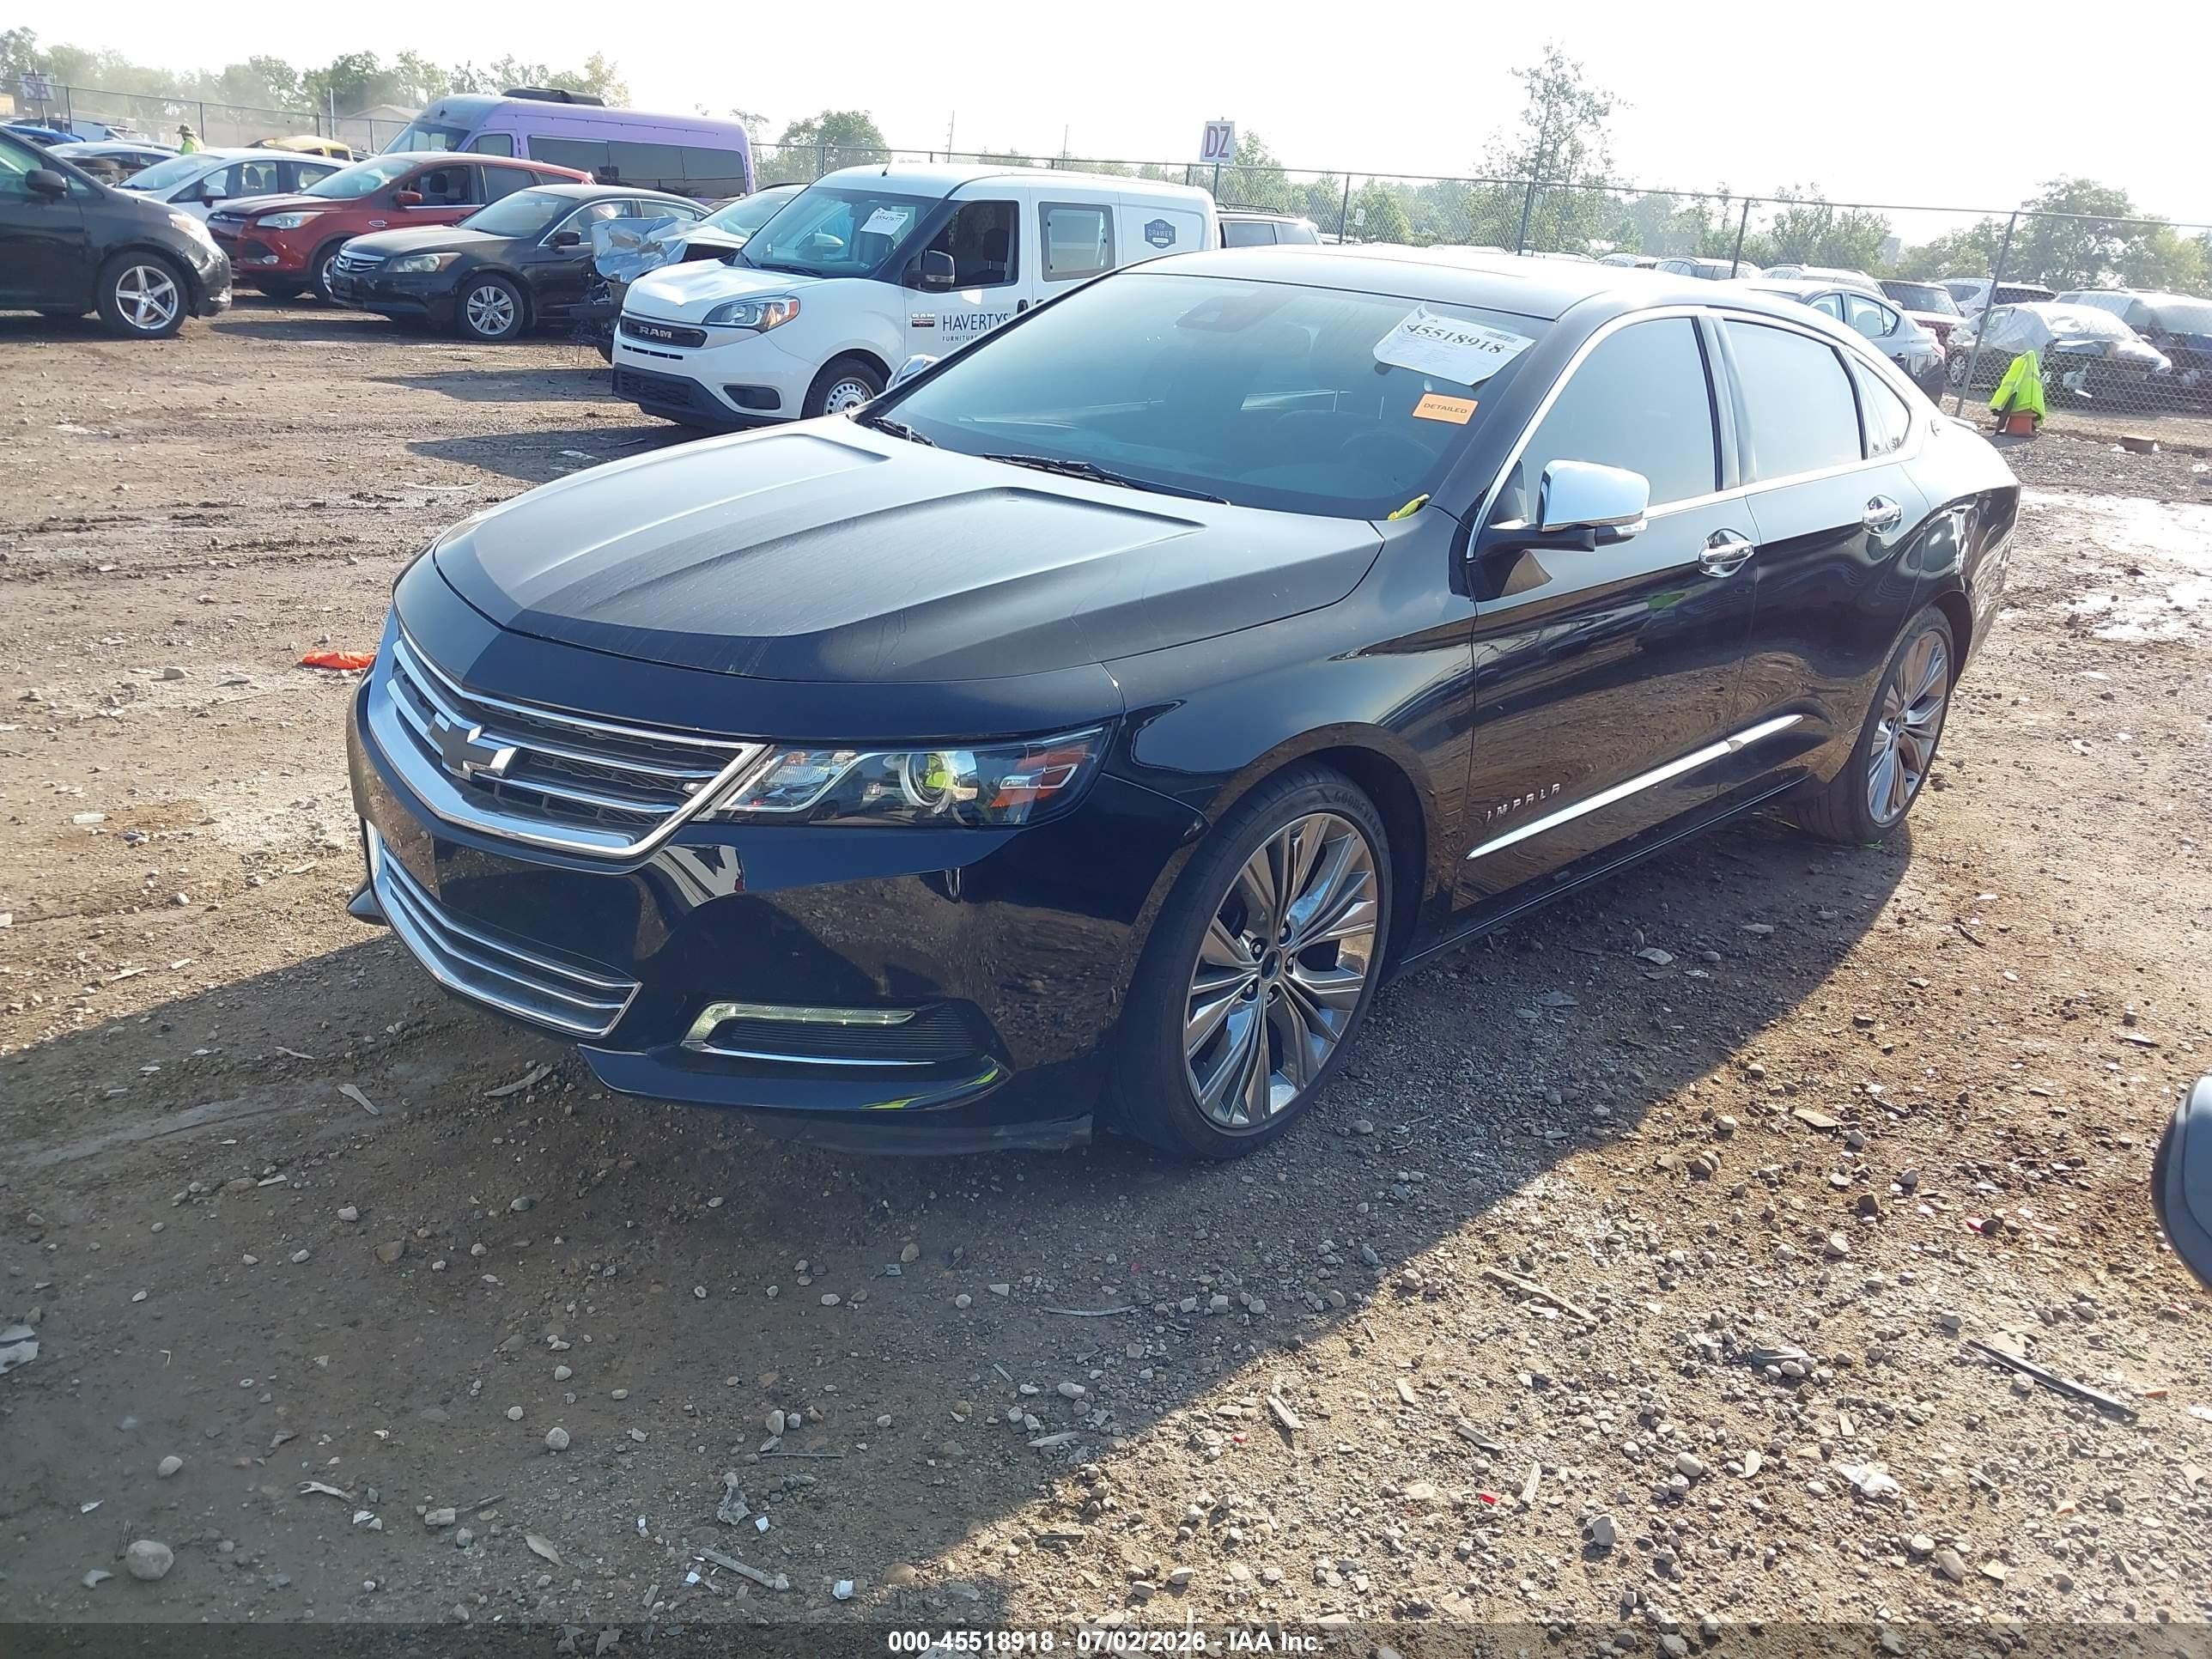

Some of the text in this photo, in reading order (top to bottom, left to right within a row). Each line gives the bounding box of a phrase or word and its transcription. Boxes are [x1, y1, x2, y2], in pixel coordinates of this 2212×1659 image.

[1204, 125, 1231, 158] DZ
[1147, 228, 1173, 238] DRAWER
[639, 325, 672, 338] RAM
[1406, 324, 1505, 354] 45518918
[1423, 403, 1468, 414] DETAILED
[1486, 783, 1560, 823] IMPALA
